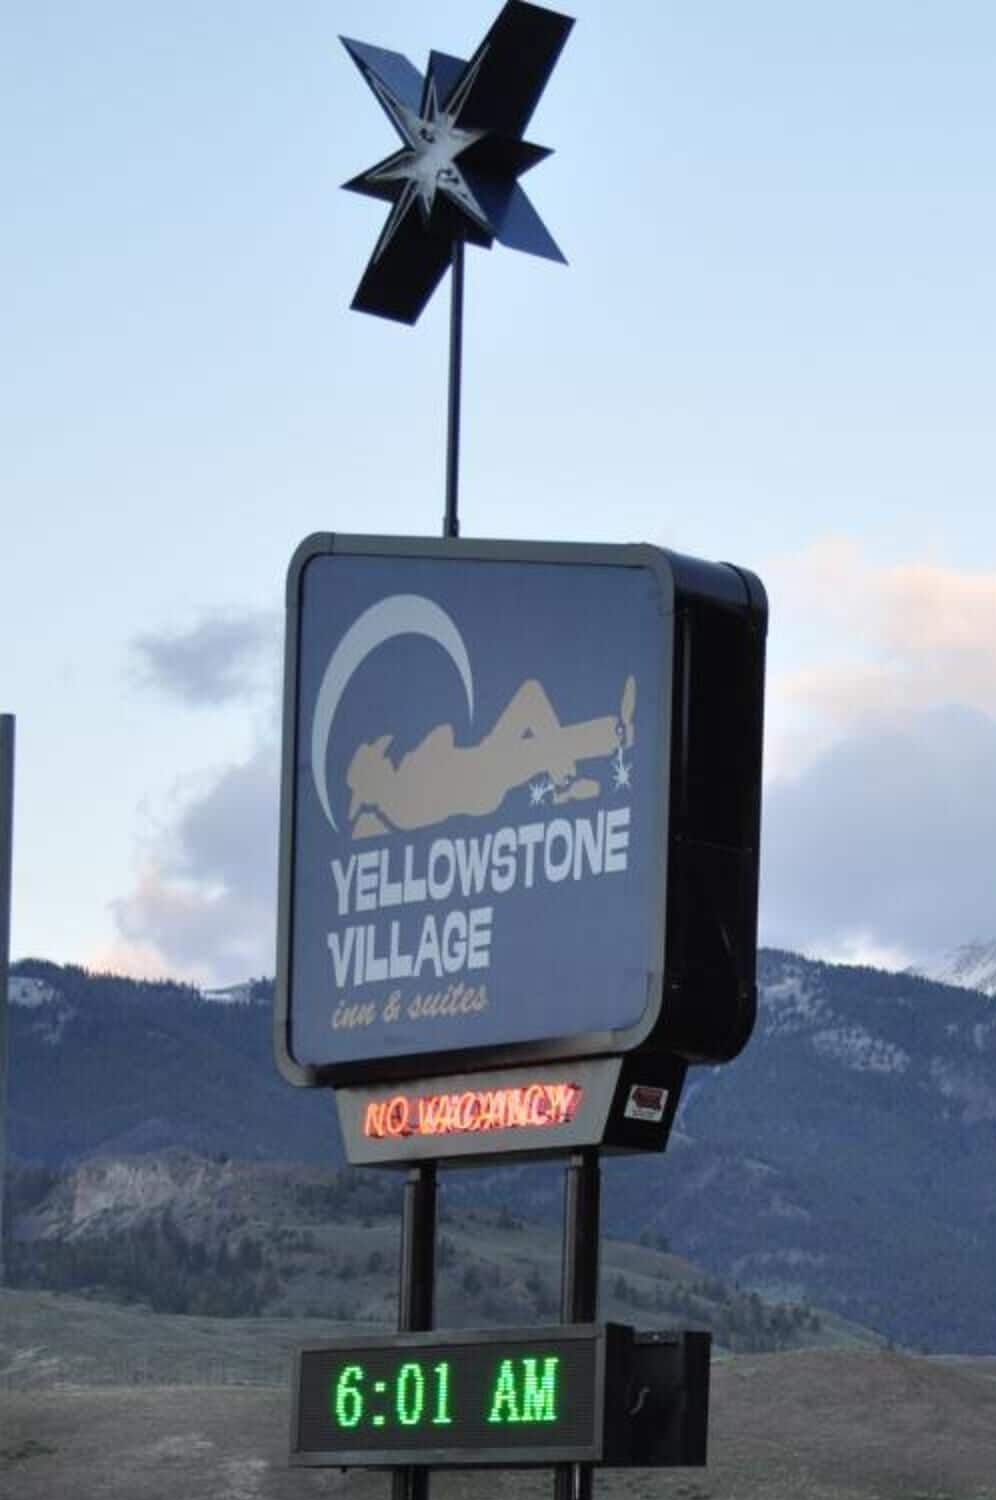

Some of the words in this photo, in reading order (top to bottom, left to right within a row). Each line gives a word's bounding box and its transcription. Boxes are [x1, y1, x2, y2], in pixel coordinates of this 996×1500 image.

[330, 807, 632, 916] YELLOWSTONE
[327, 906, 495, 988] VILLAGE
[332, 999, 376, 1031] inn
[383, 989, 402, 1024] &
[408, 981, 488, 1020] suites
[364, 1096, 409, 1138] NO
[418, 1082, 582, 1135] VACANCY
[335, 1362, 453, 1427] 6:01
[488, 1356, 559, 1423] AM
